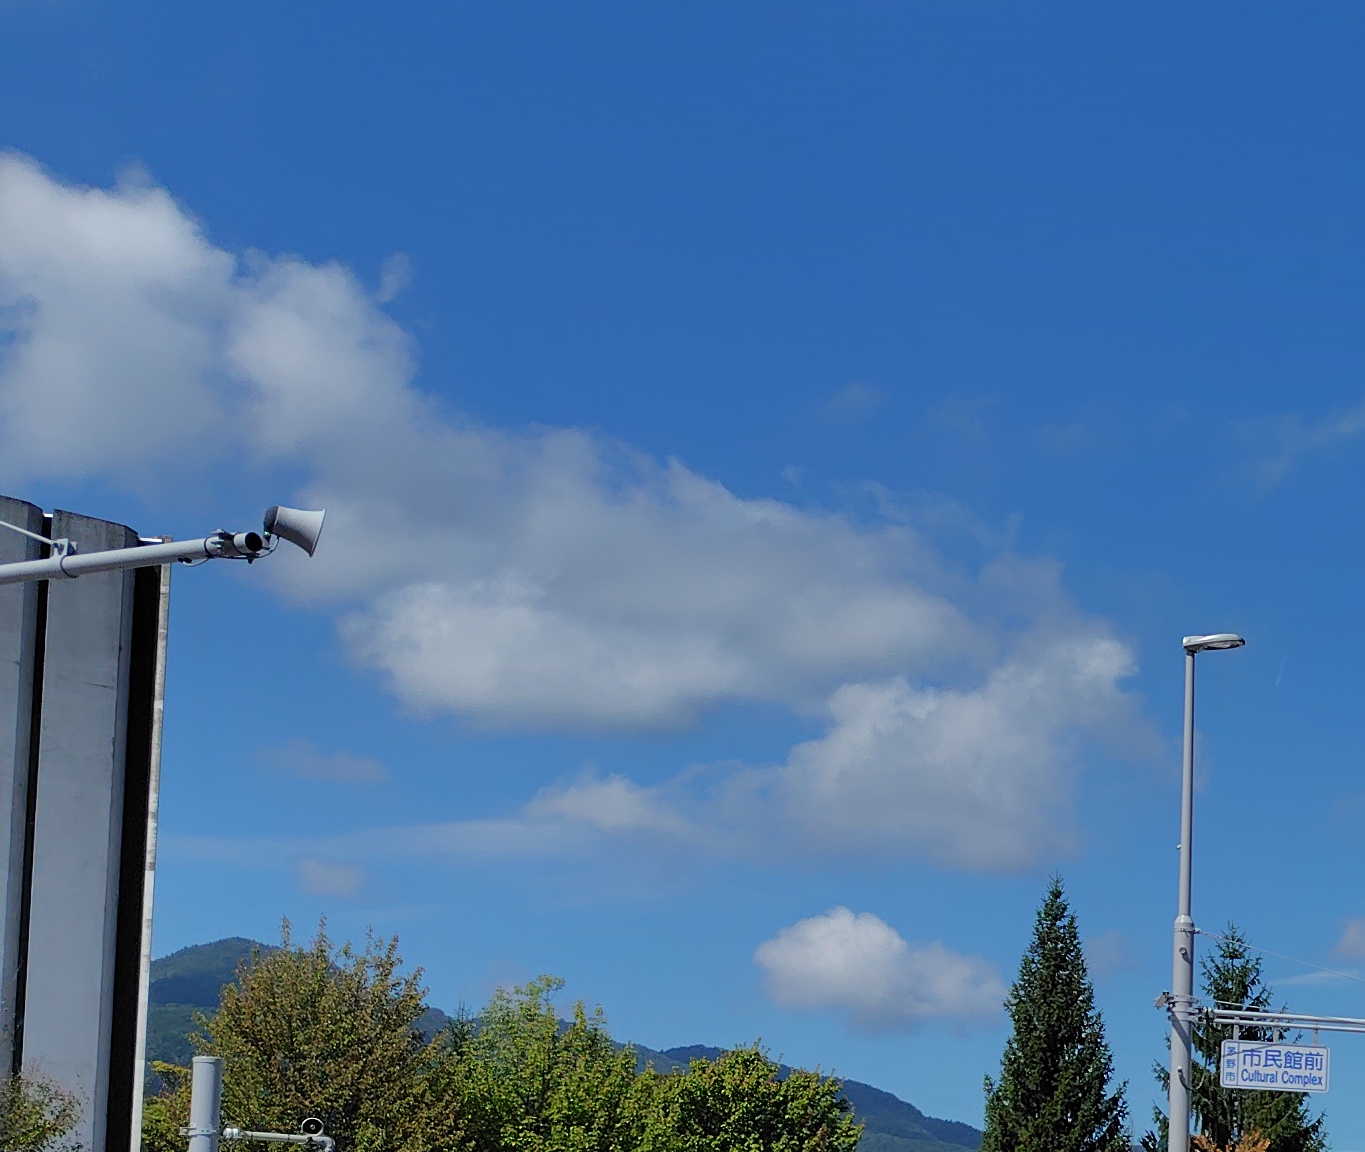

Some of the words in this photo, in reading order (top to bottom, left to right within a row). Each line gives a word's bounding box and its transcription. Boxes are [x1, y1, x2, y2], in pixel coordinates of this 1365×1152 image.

[1242, 1048, 1324, 1071] 市民館前
[1241, 1068, 1278, 1083] Cultural
[1281, 1070, 1323, 1087] Complex
